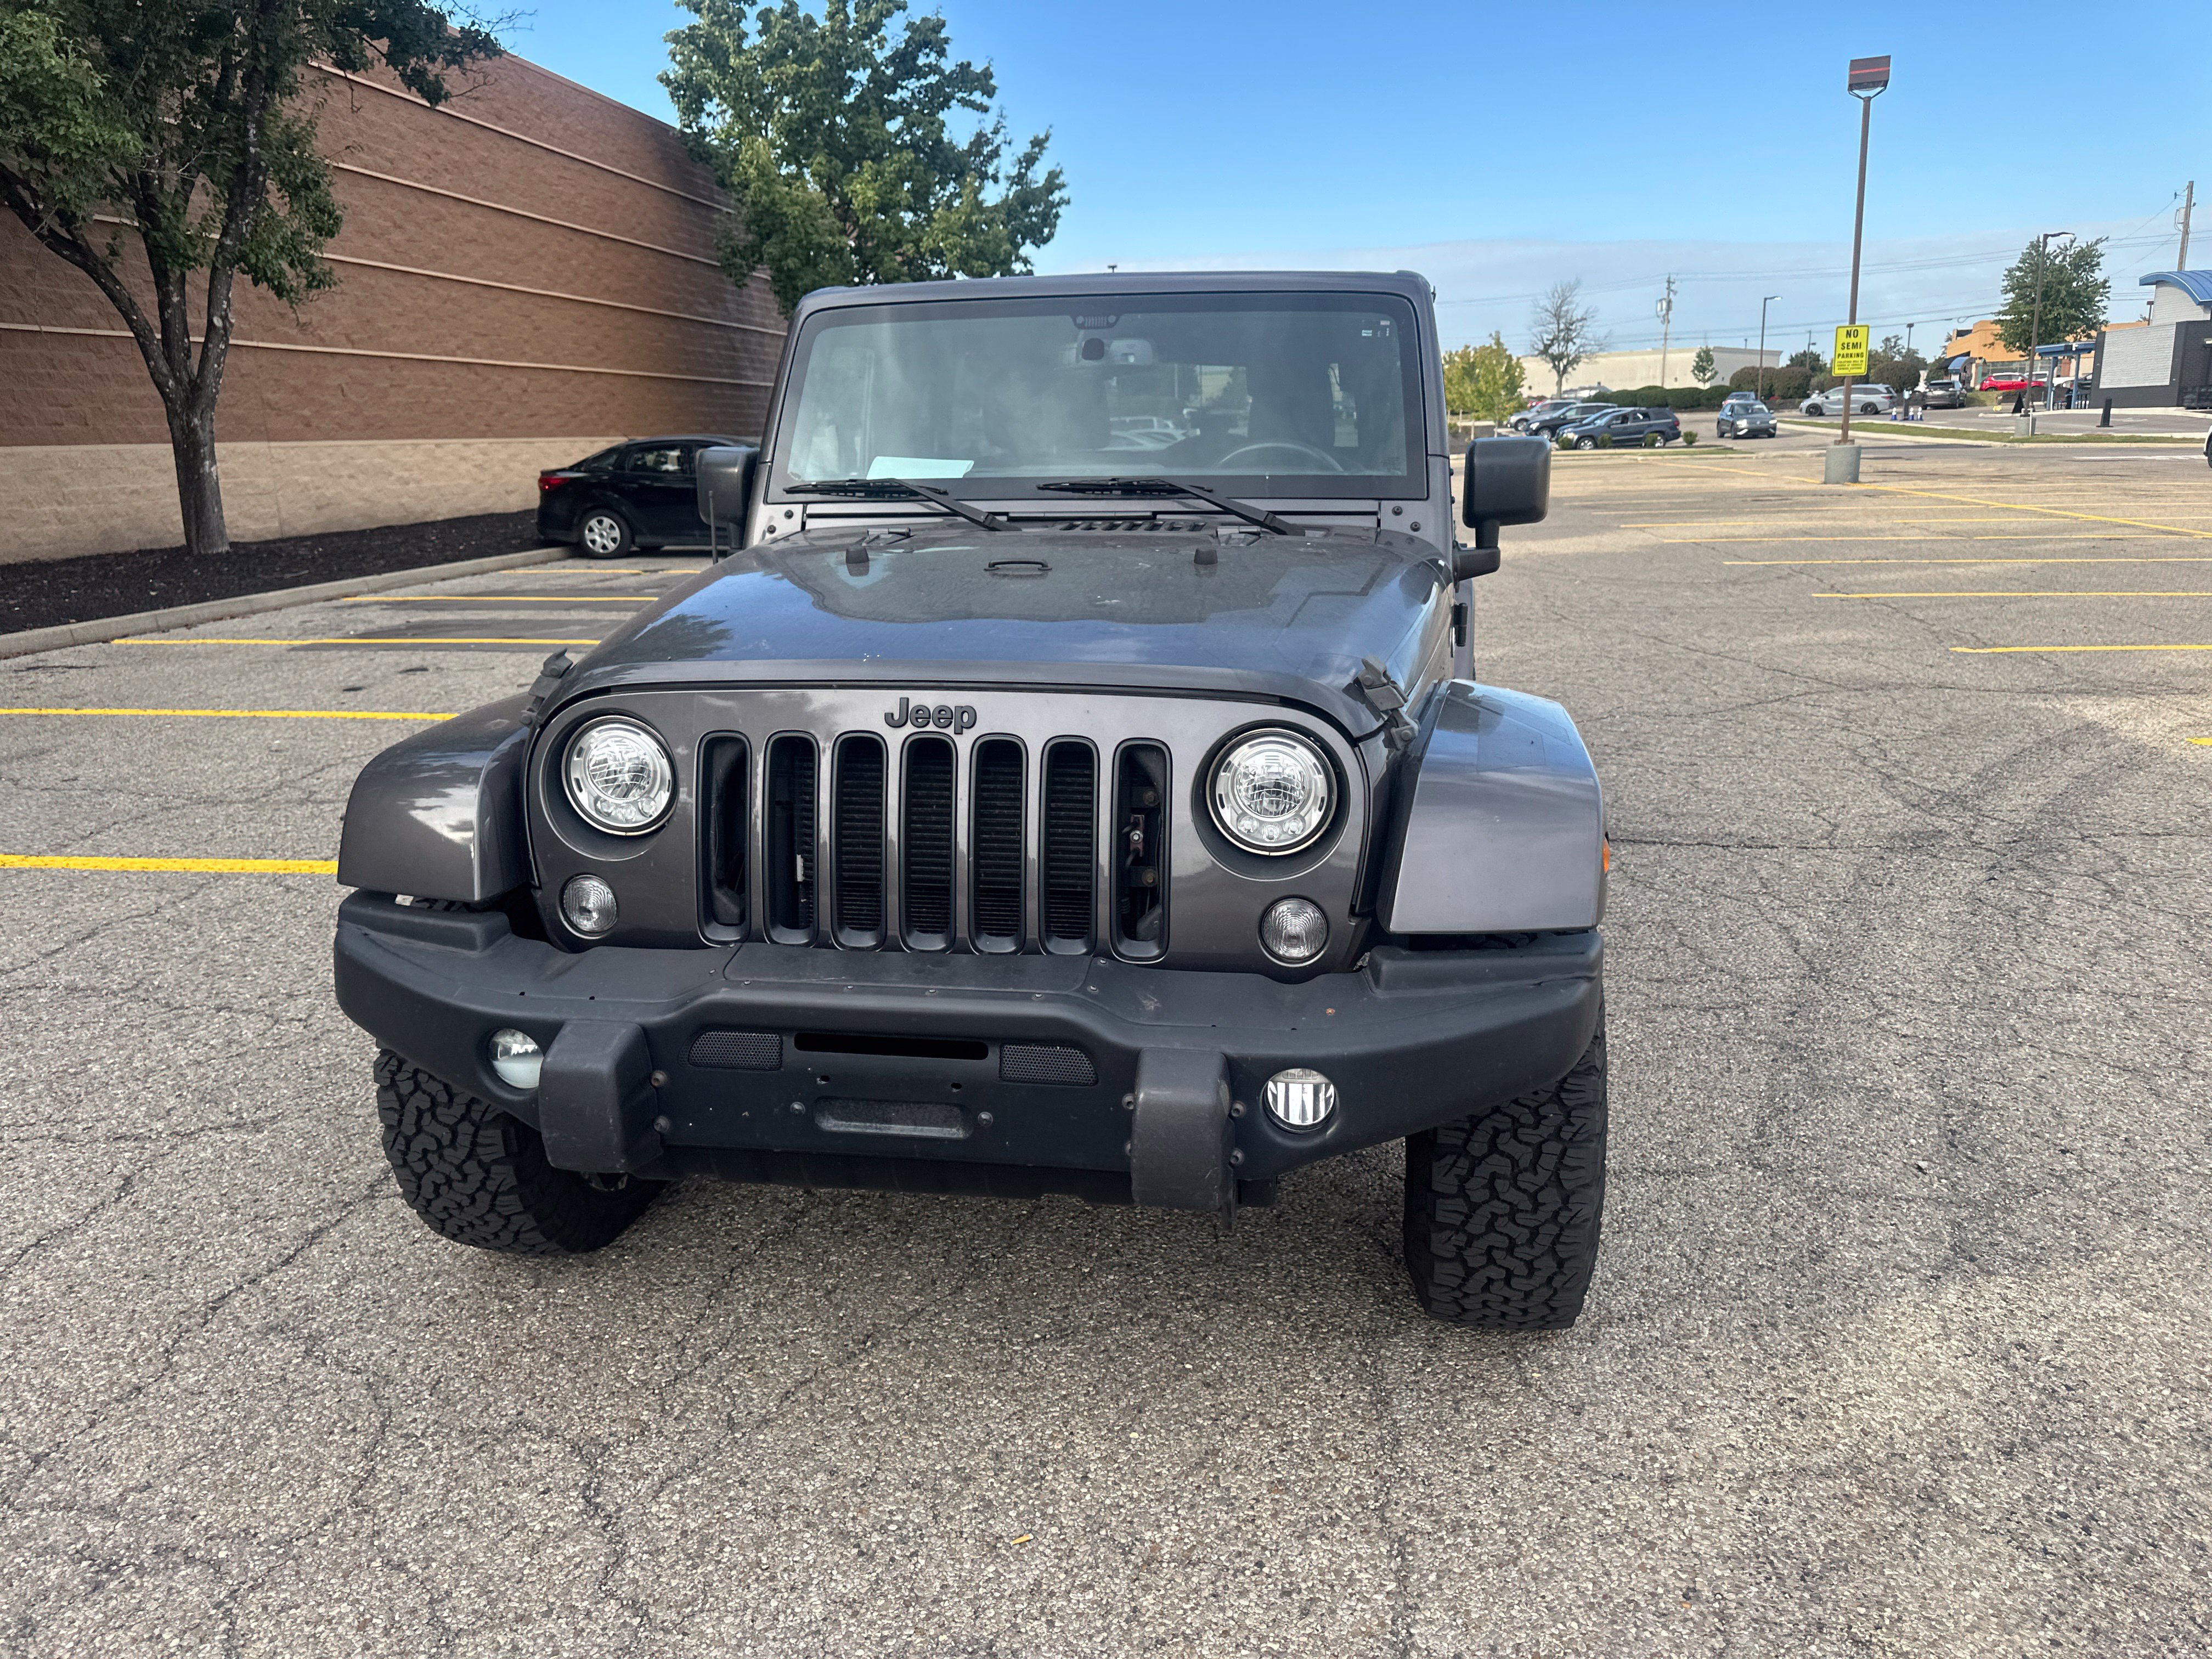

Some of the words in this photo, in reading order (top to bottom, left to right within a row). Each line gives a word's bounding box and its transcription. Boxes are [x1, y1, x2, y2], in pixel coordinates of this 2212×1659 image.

[1846, 329, 1859, 338] NO
[1841, 342, 1862, 351] SEMI
[884, 697, 977, 735] Jeep
